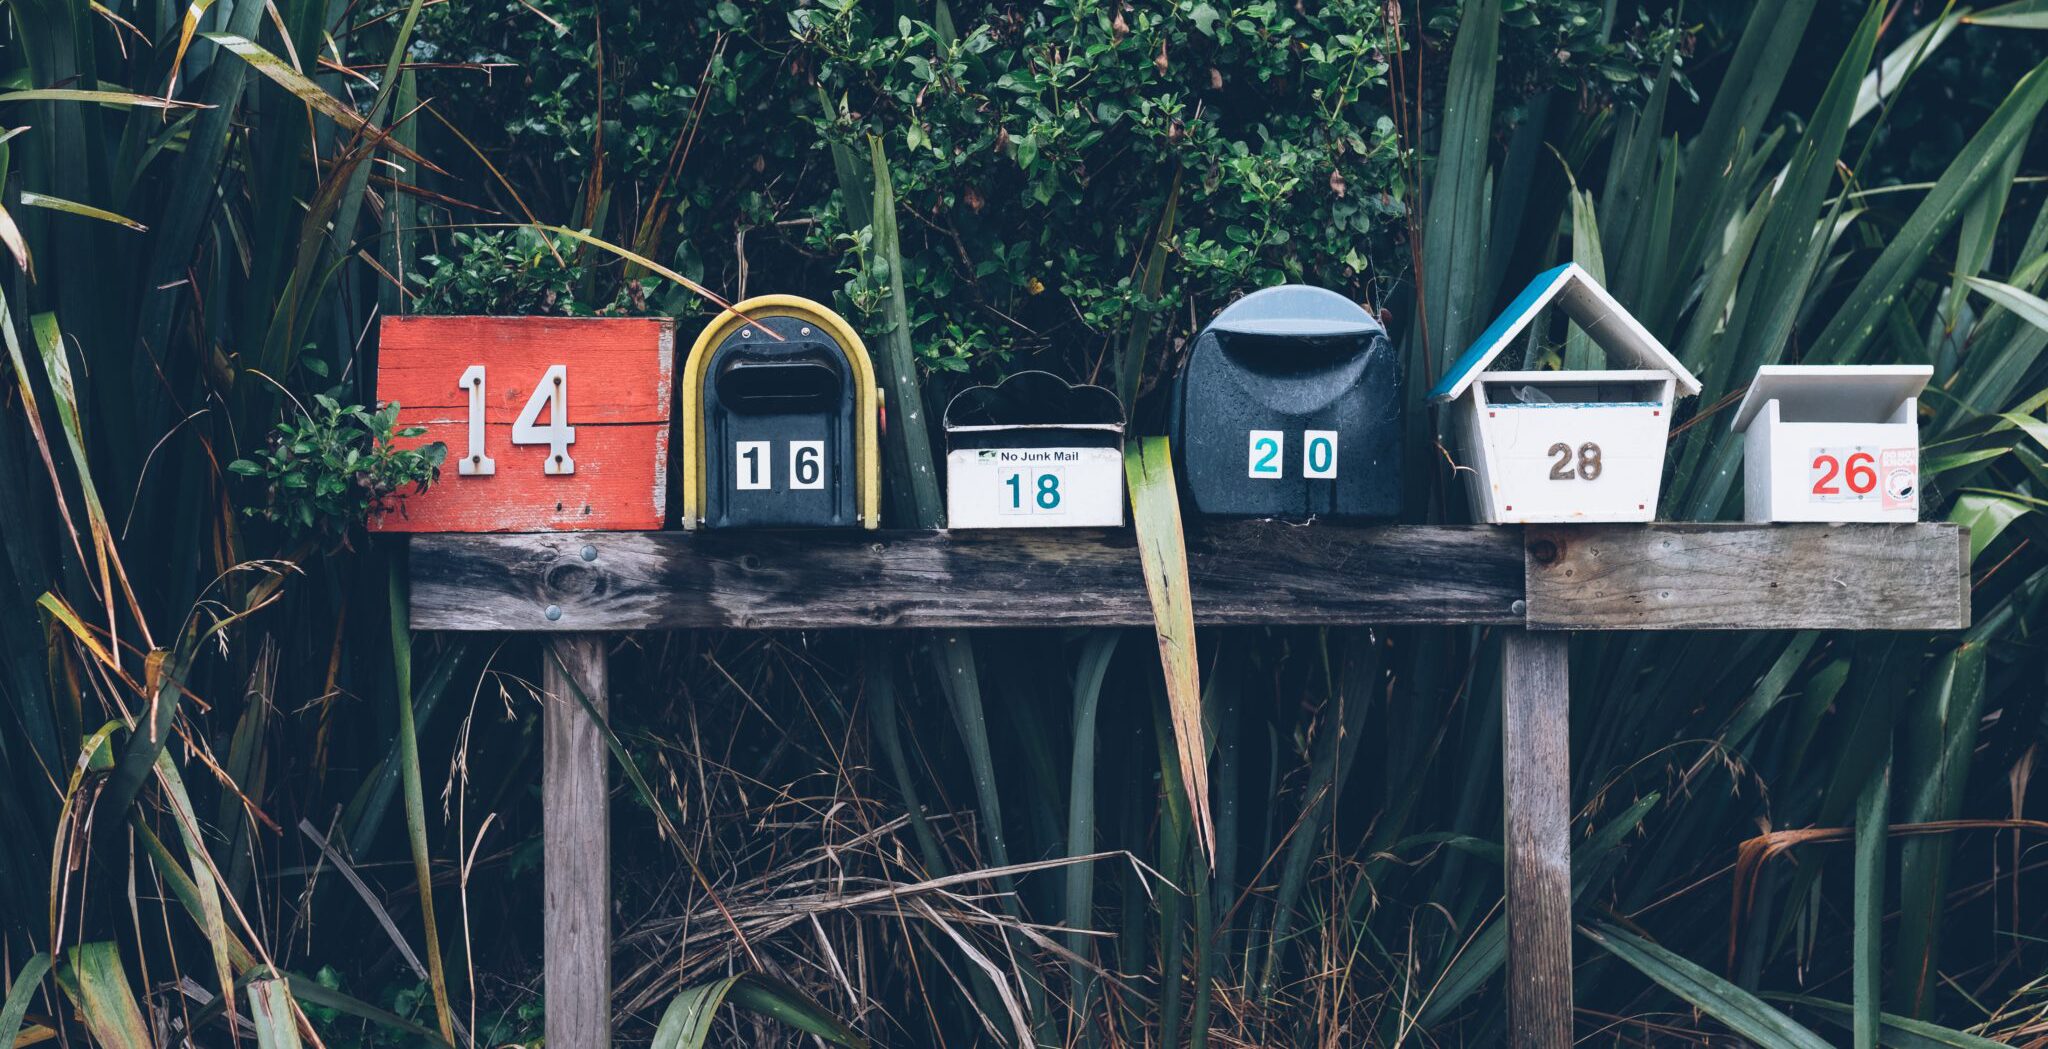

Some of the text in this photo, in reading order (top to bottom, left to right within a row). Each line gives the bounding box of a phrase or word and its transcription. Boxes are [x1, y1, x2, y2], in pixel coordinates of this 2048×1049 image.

[459, 365, 575, 475] 14
[743, 447, 819, 484] 16
[1001, 451, 1079, 461] No Junk Mail
[1255, 437, 1332, 472] 20
[1548, 442, 1603, 480] 28
[1812, 452, 1877, 494] 26
[1006, 473, 1060, 509] 18
